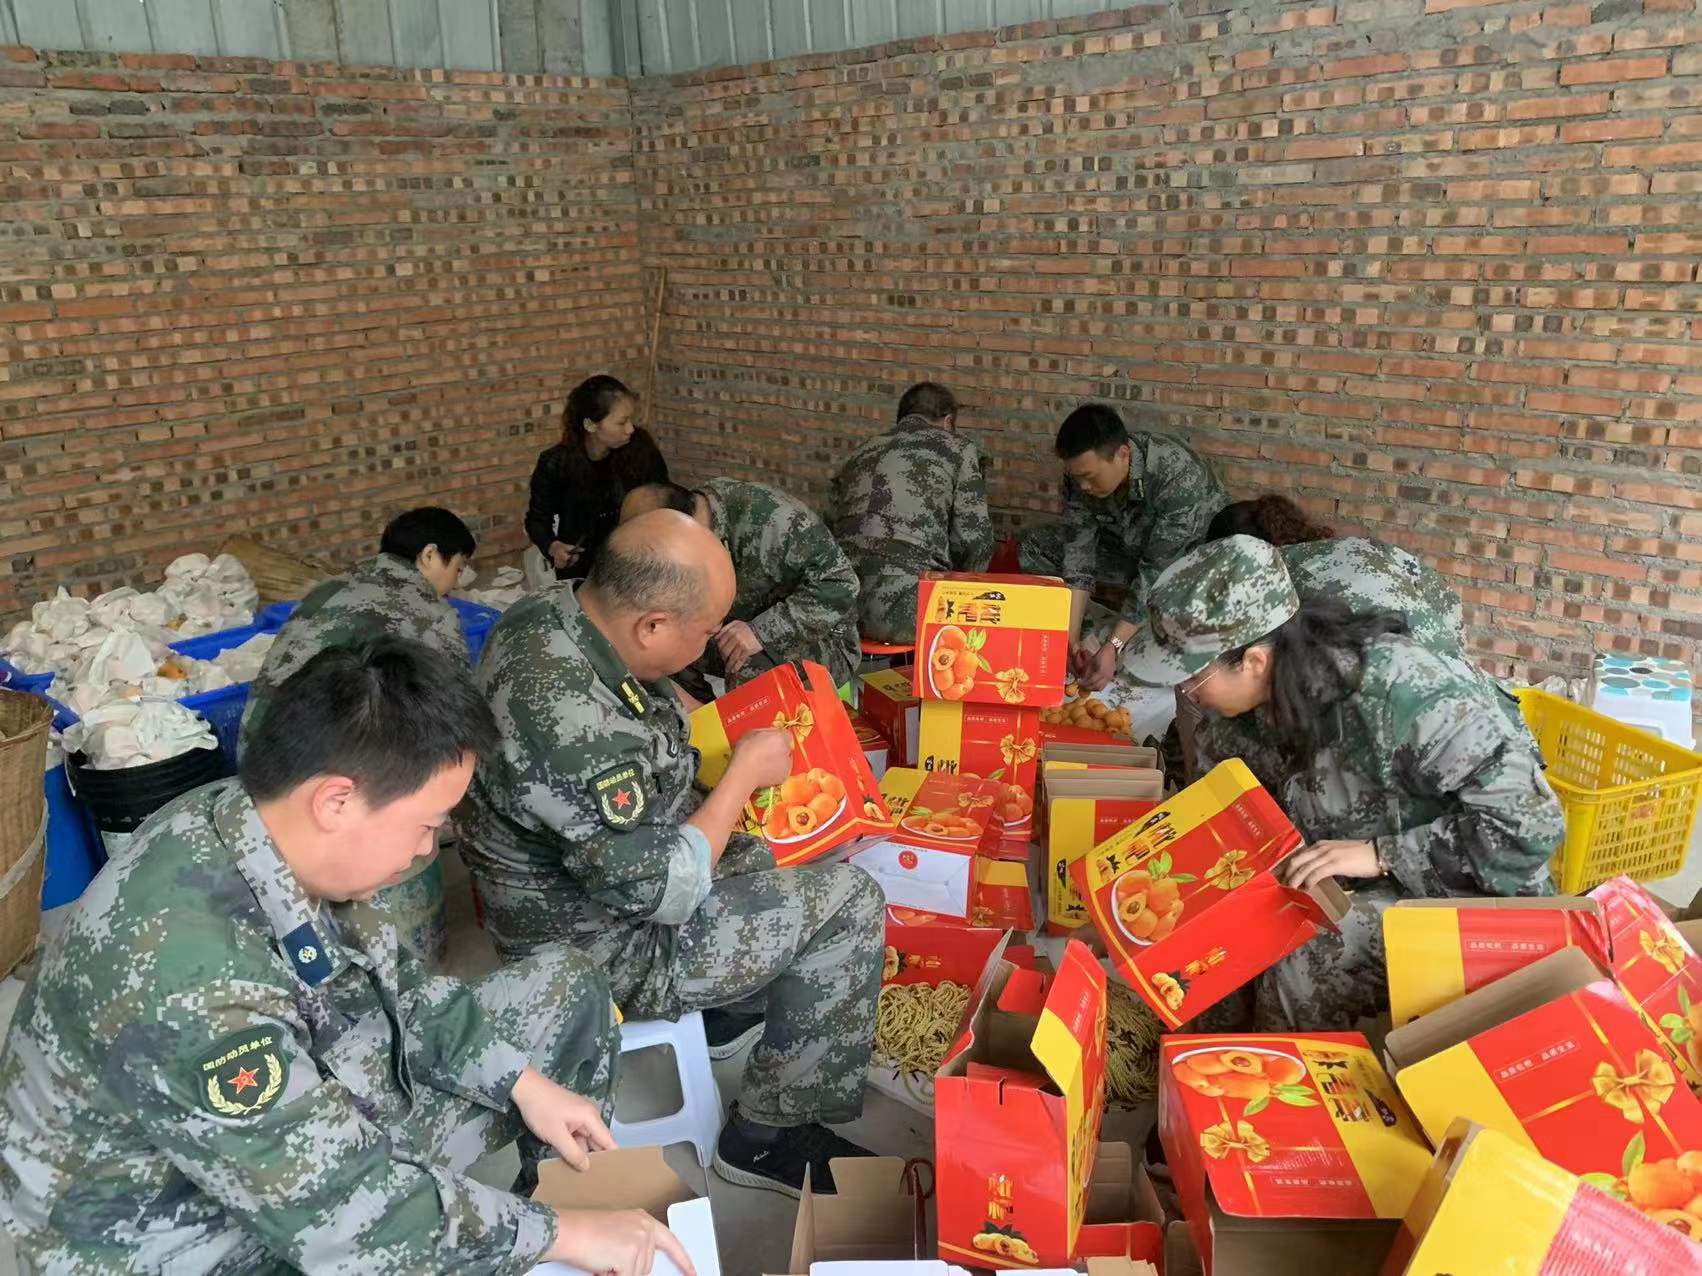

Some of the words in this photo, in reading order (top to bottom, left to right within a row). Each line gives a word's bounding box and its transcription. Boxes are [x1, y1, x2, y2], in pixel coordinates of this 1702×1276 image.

[203, 1036, 273, 1071] 国防动员单位
